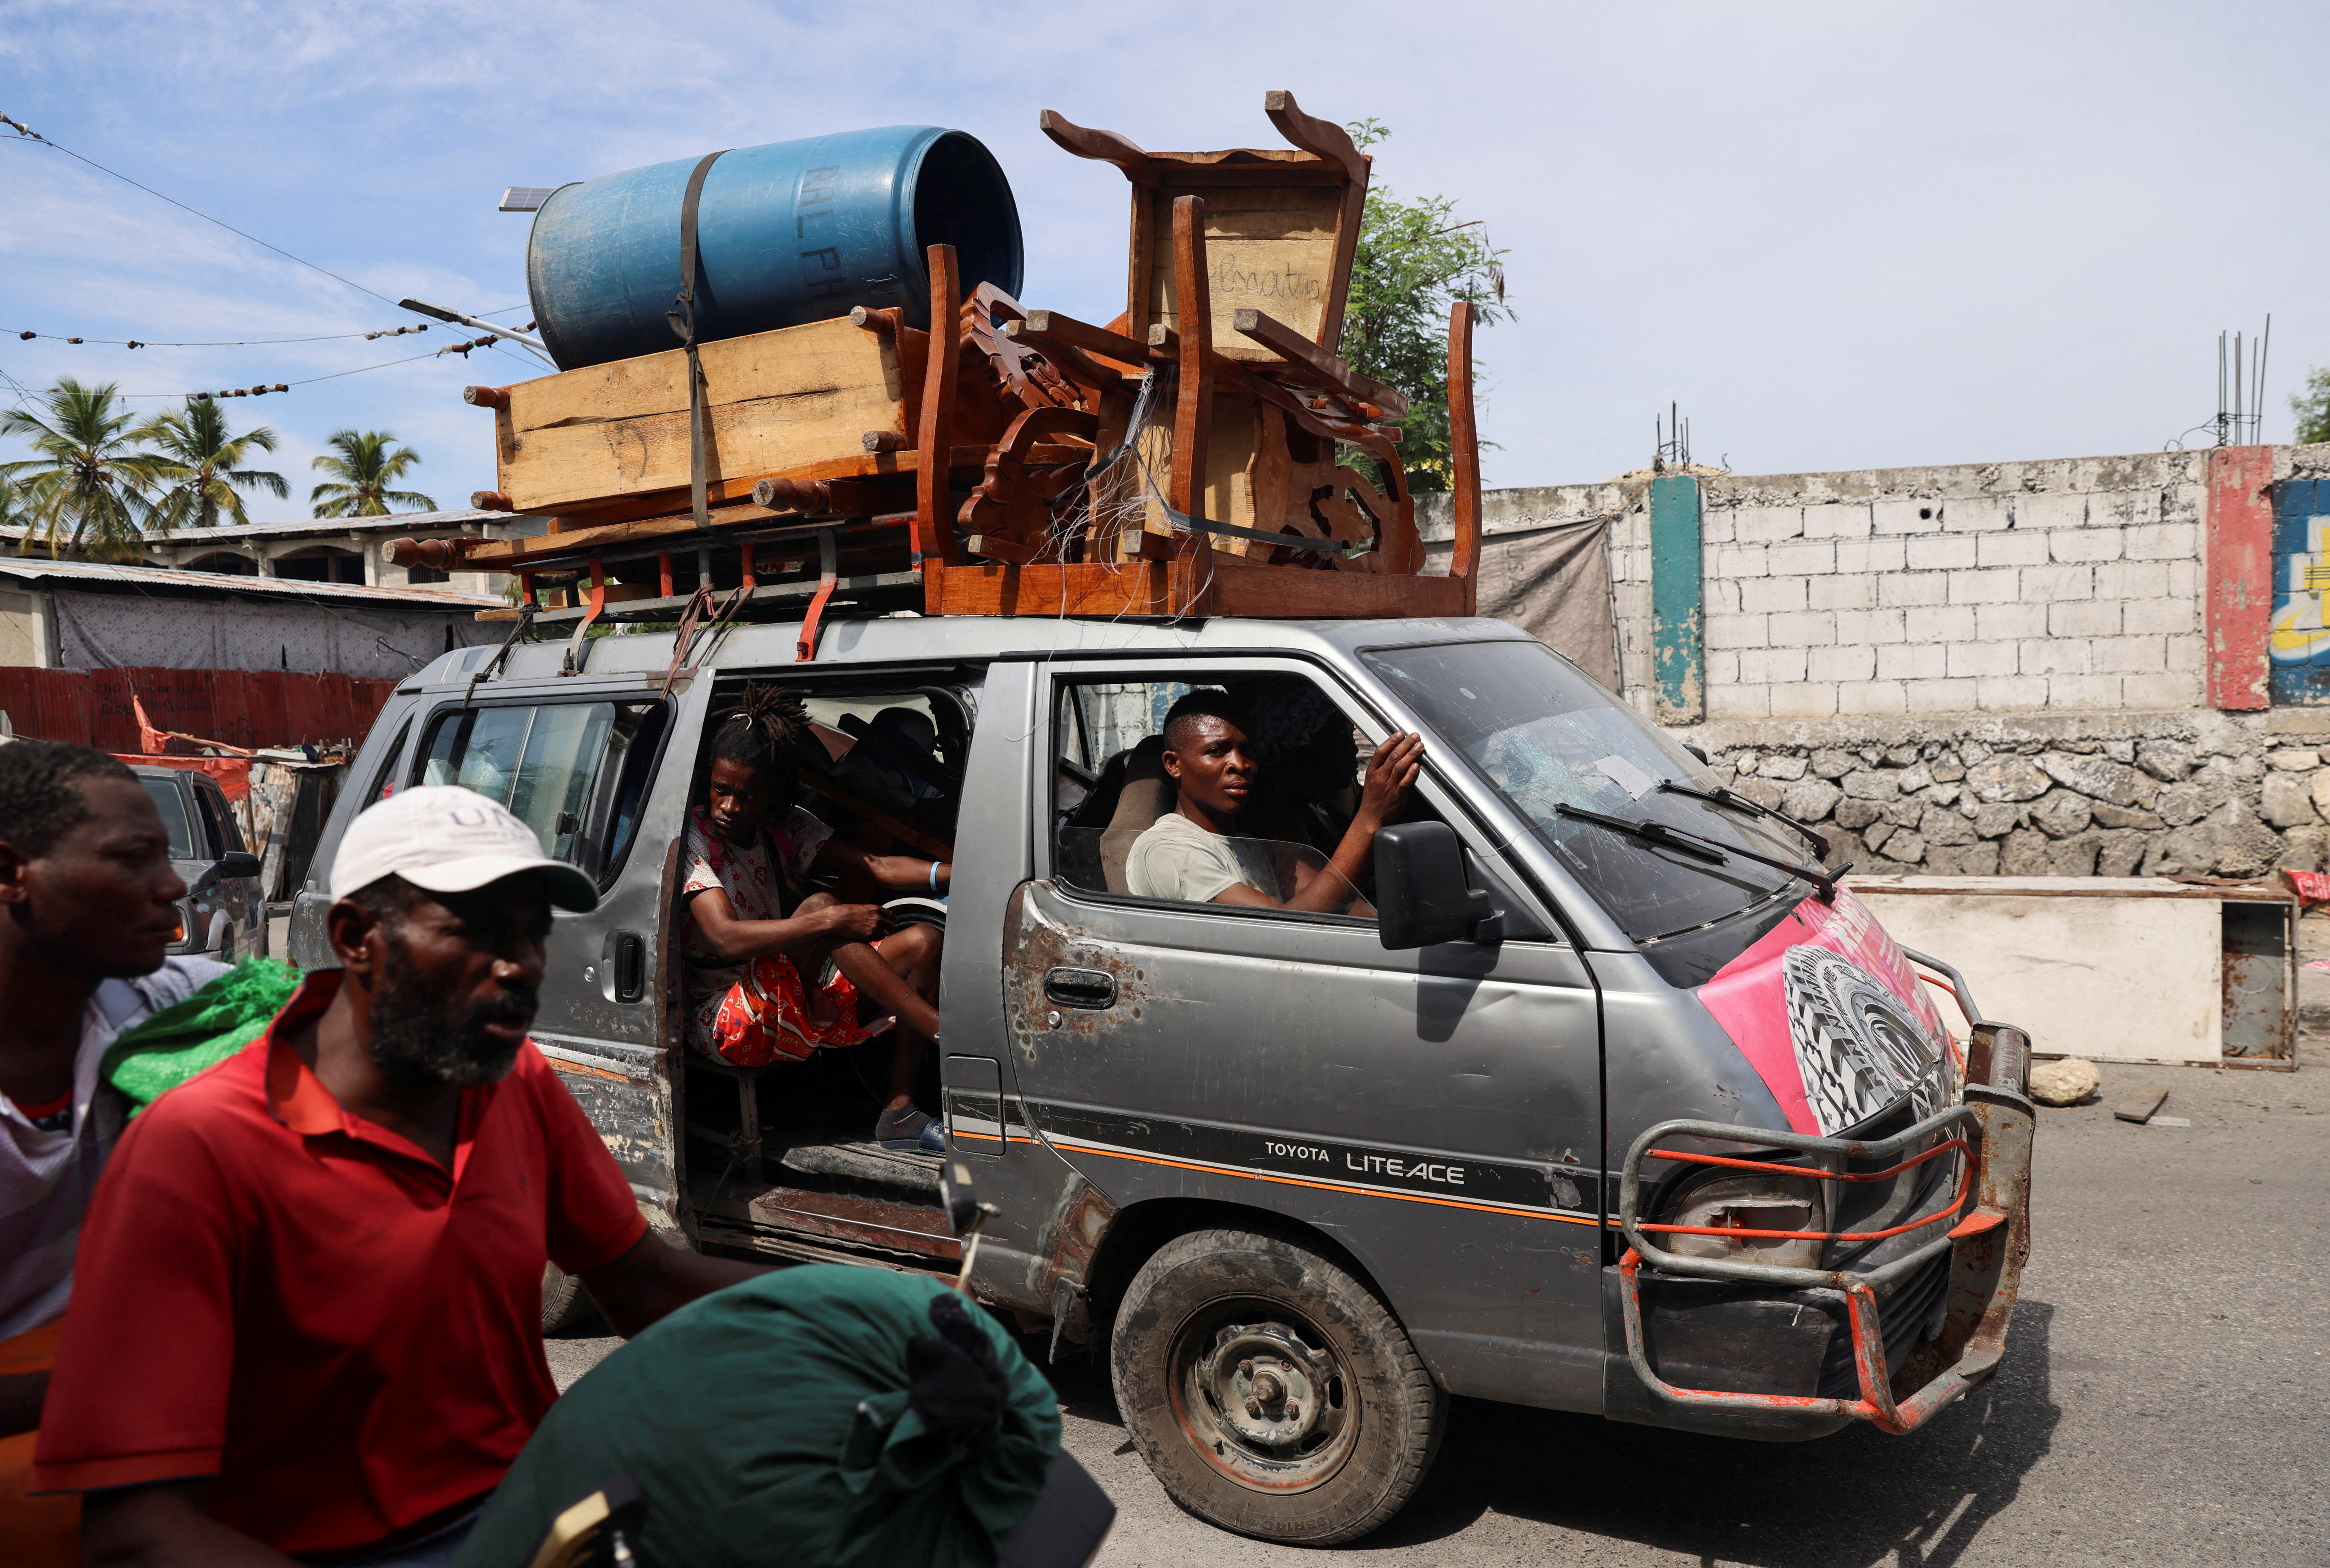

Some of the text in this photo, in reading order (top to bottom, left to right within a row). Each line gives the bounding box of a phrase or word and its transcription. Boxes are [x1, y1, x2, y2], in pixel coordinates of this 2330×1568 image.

[1265, 1142, 1465, 1185] TOYOTA LITEACE
[1262, 1513, 1333, 1532] 185R14C
